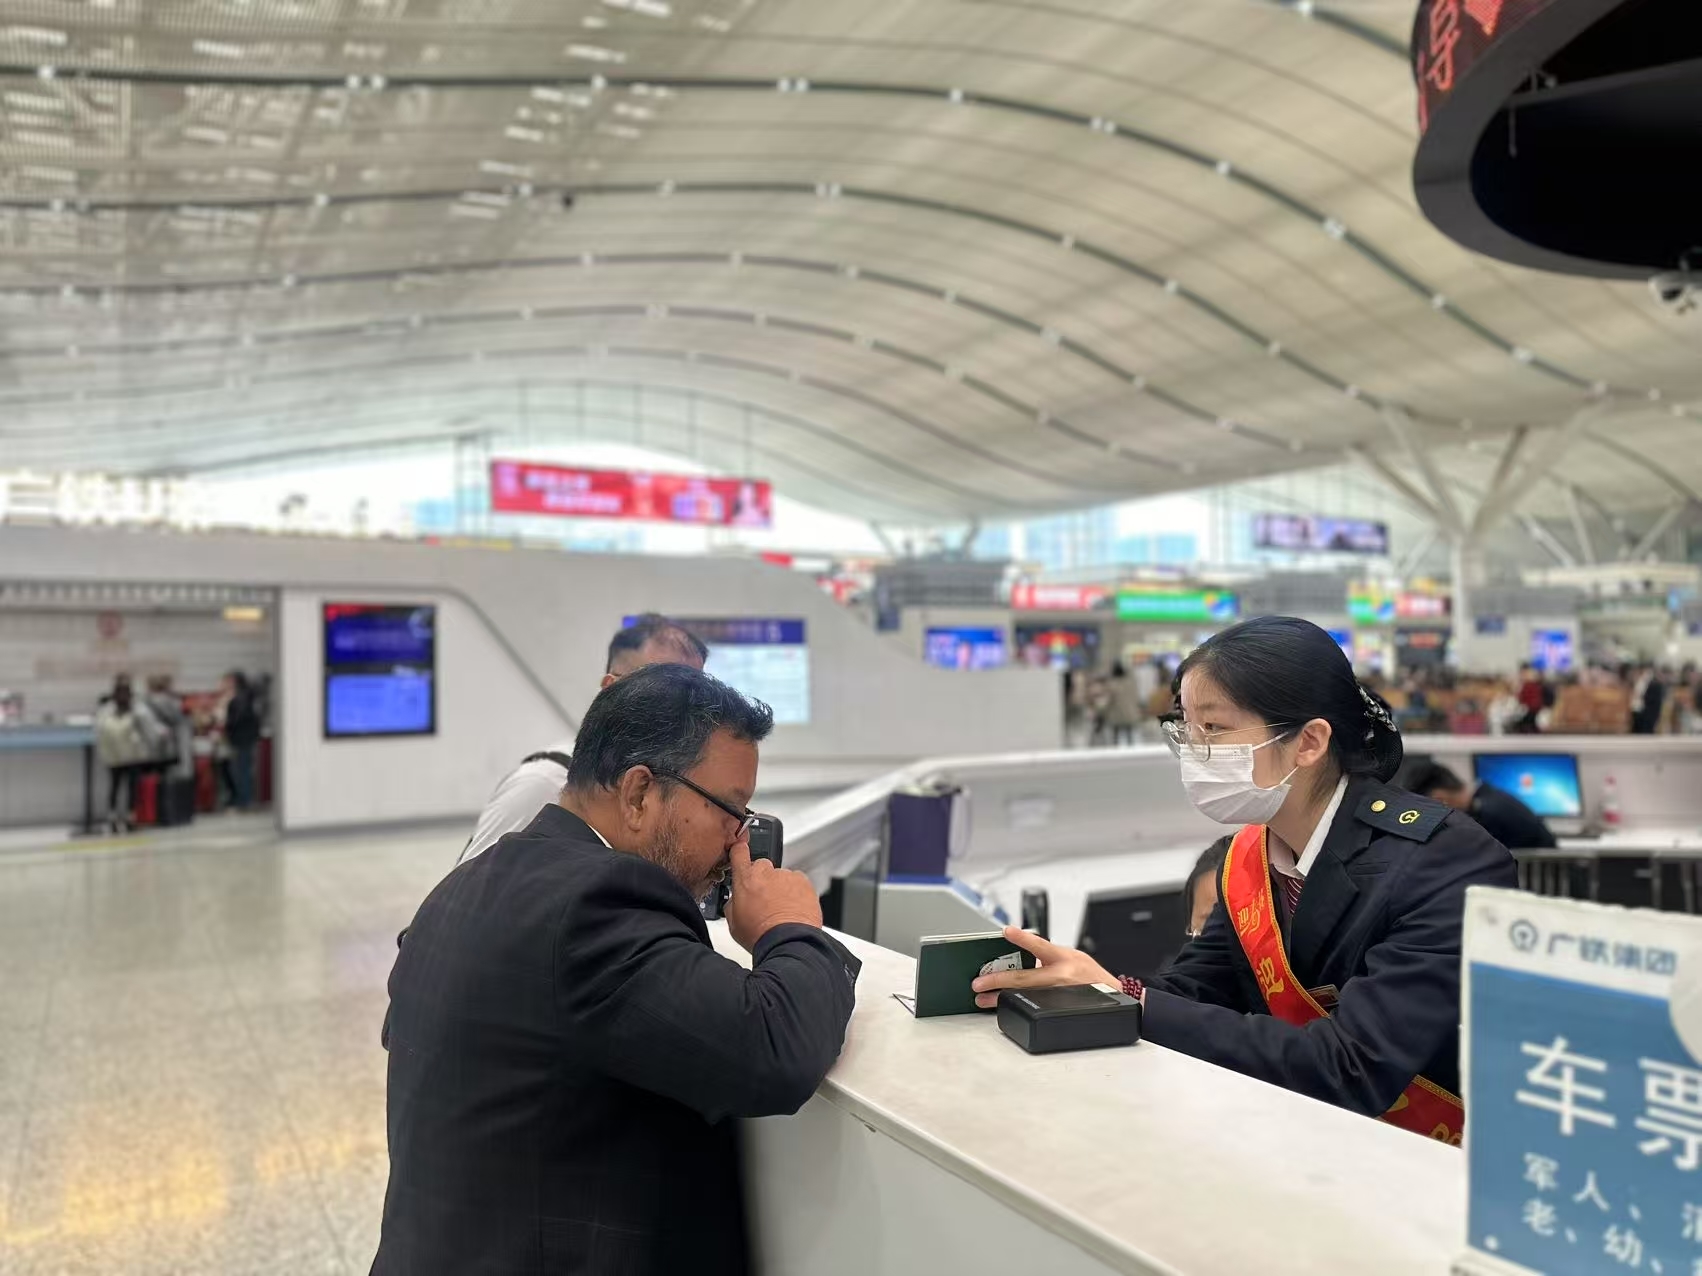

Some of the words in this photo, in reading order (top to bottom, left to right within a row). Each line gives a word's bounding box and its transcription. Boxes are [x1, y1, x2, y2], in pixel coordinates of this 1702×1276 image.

[1548, 933, 1677, 976] 广铁集团
[1523, 1199, 1702, 1276] 老、幼、
